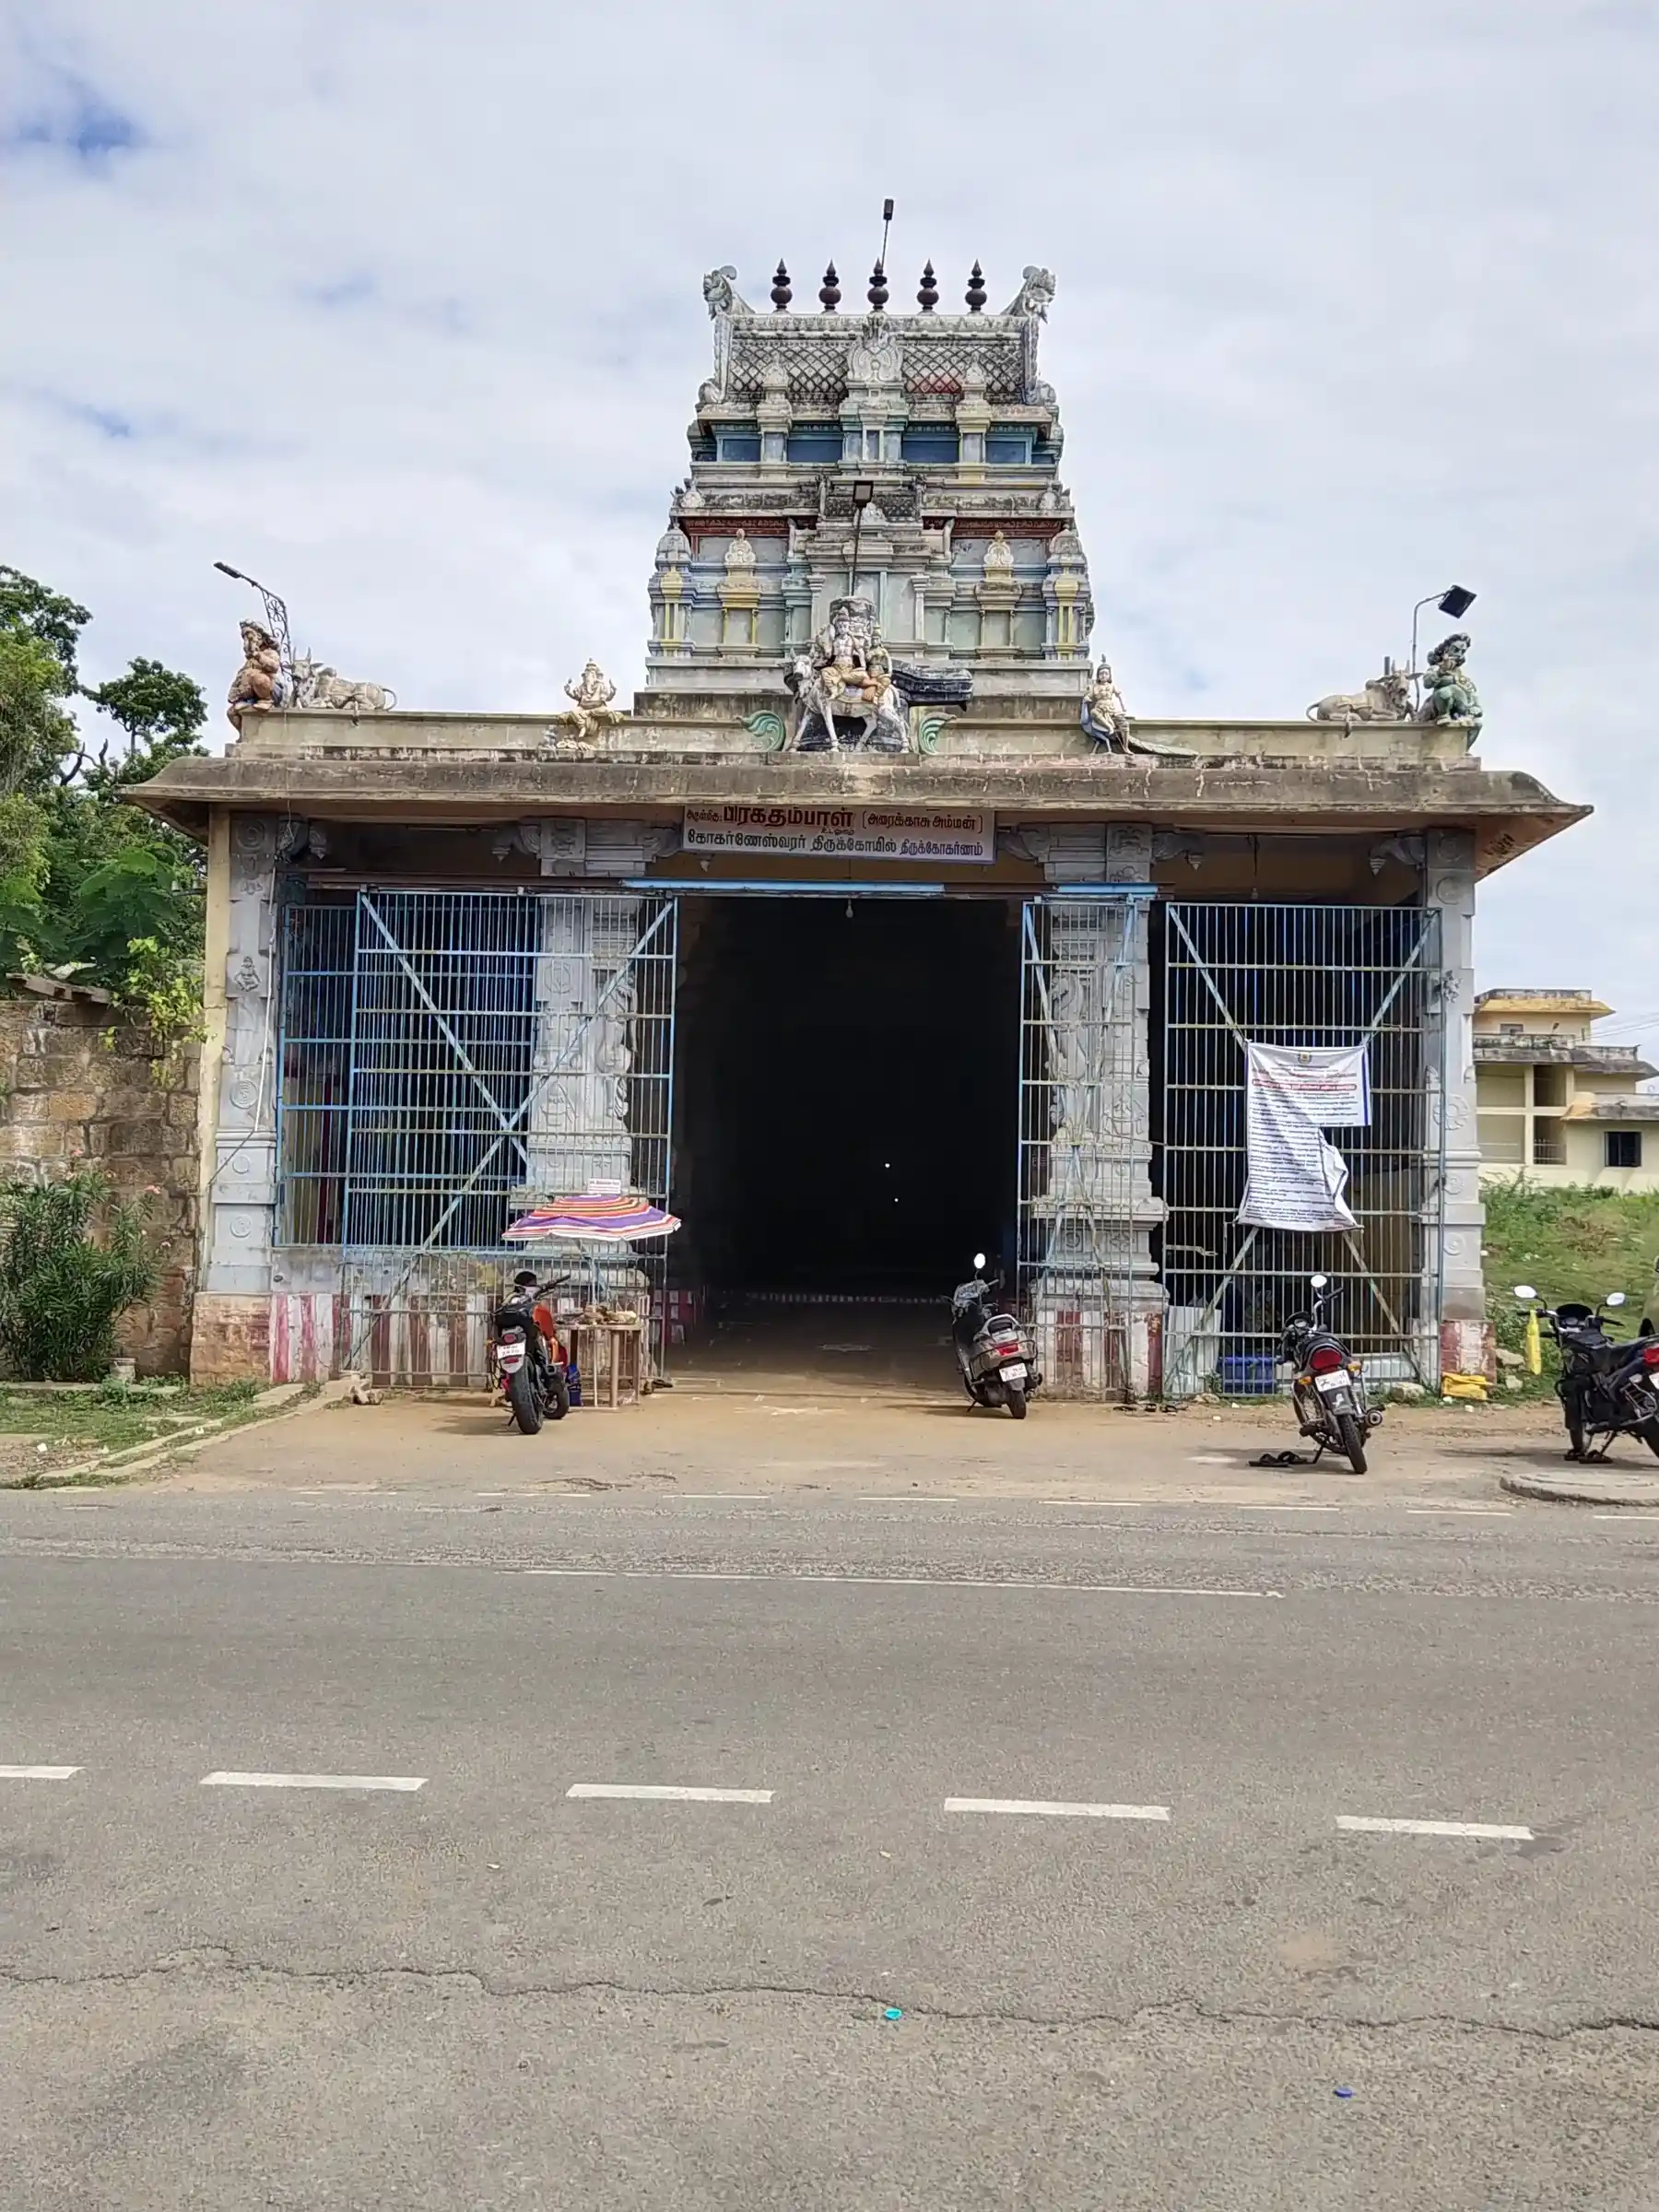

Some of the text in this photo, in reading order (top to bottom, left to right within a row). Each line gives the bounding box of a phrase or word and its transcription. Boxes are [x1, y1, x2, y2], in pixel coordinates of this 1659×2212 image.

[724, 806, 853, 827] பிரகதம்பாள்
[688, 829, 983, 855] கோகர்ணேஸ்வரர் திருக்கோயில் திருக்கோகர்ணம்
